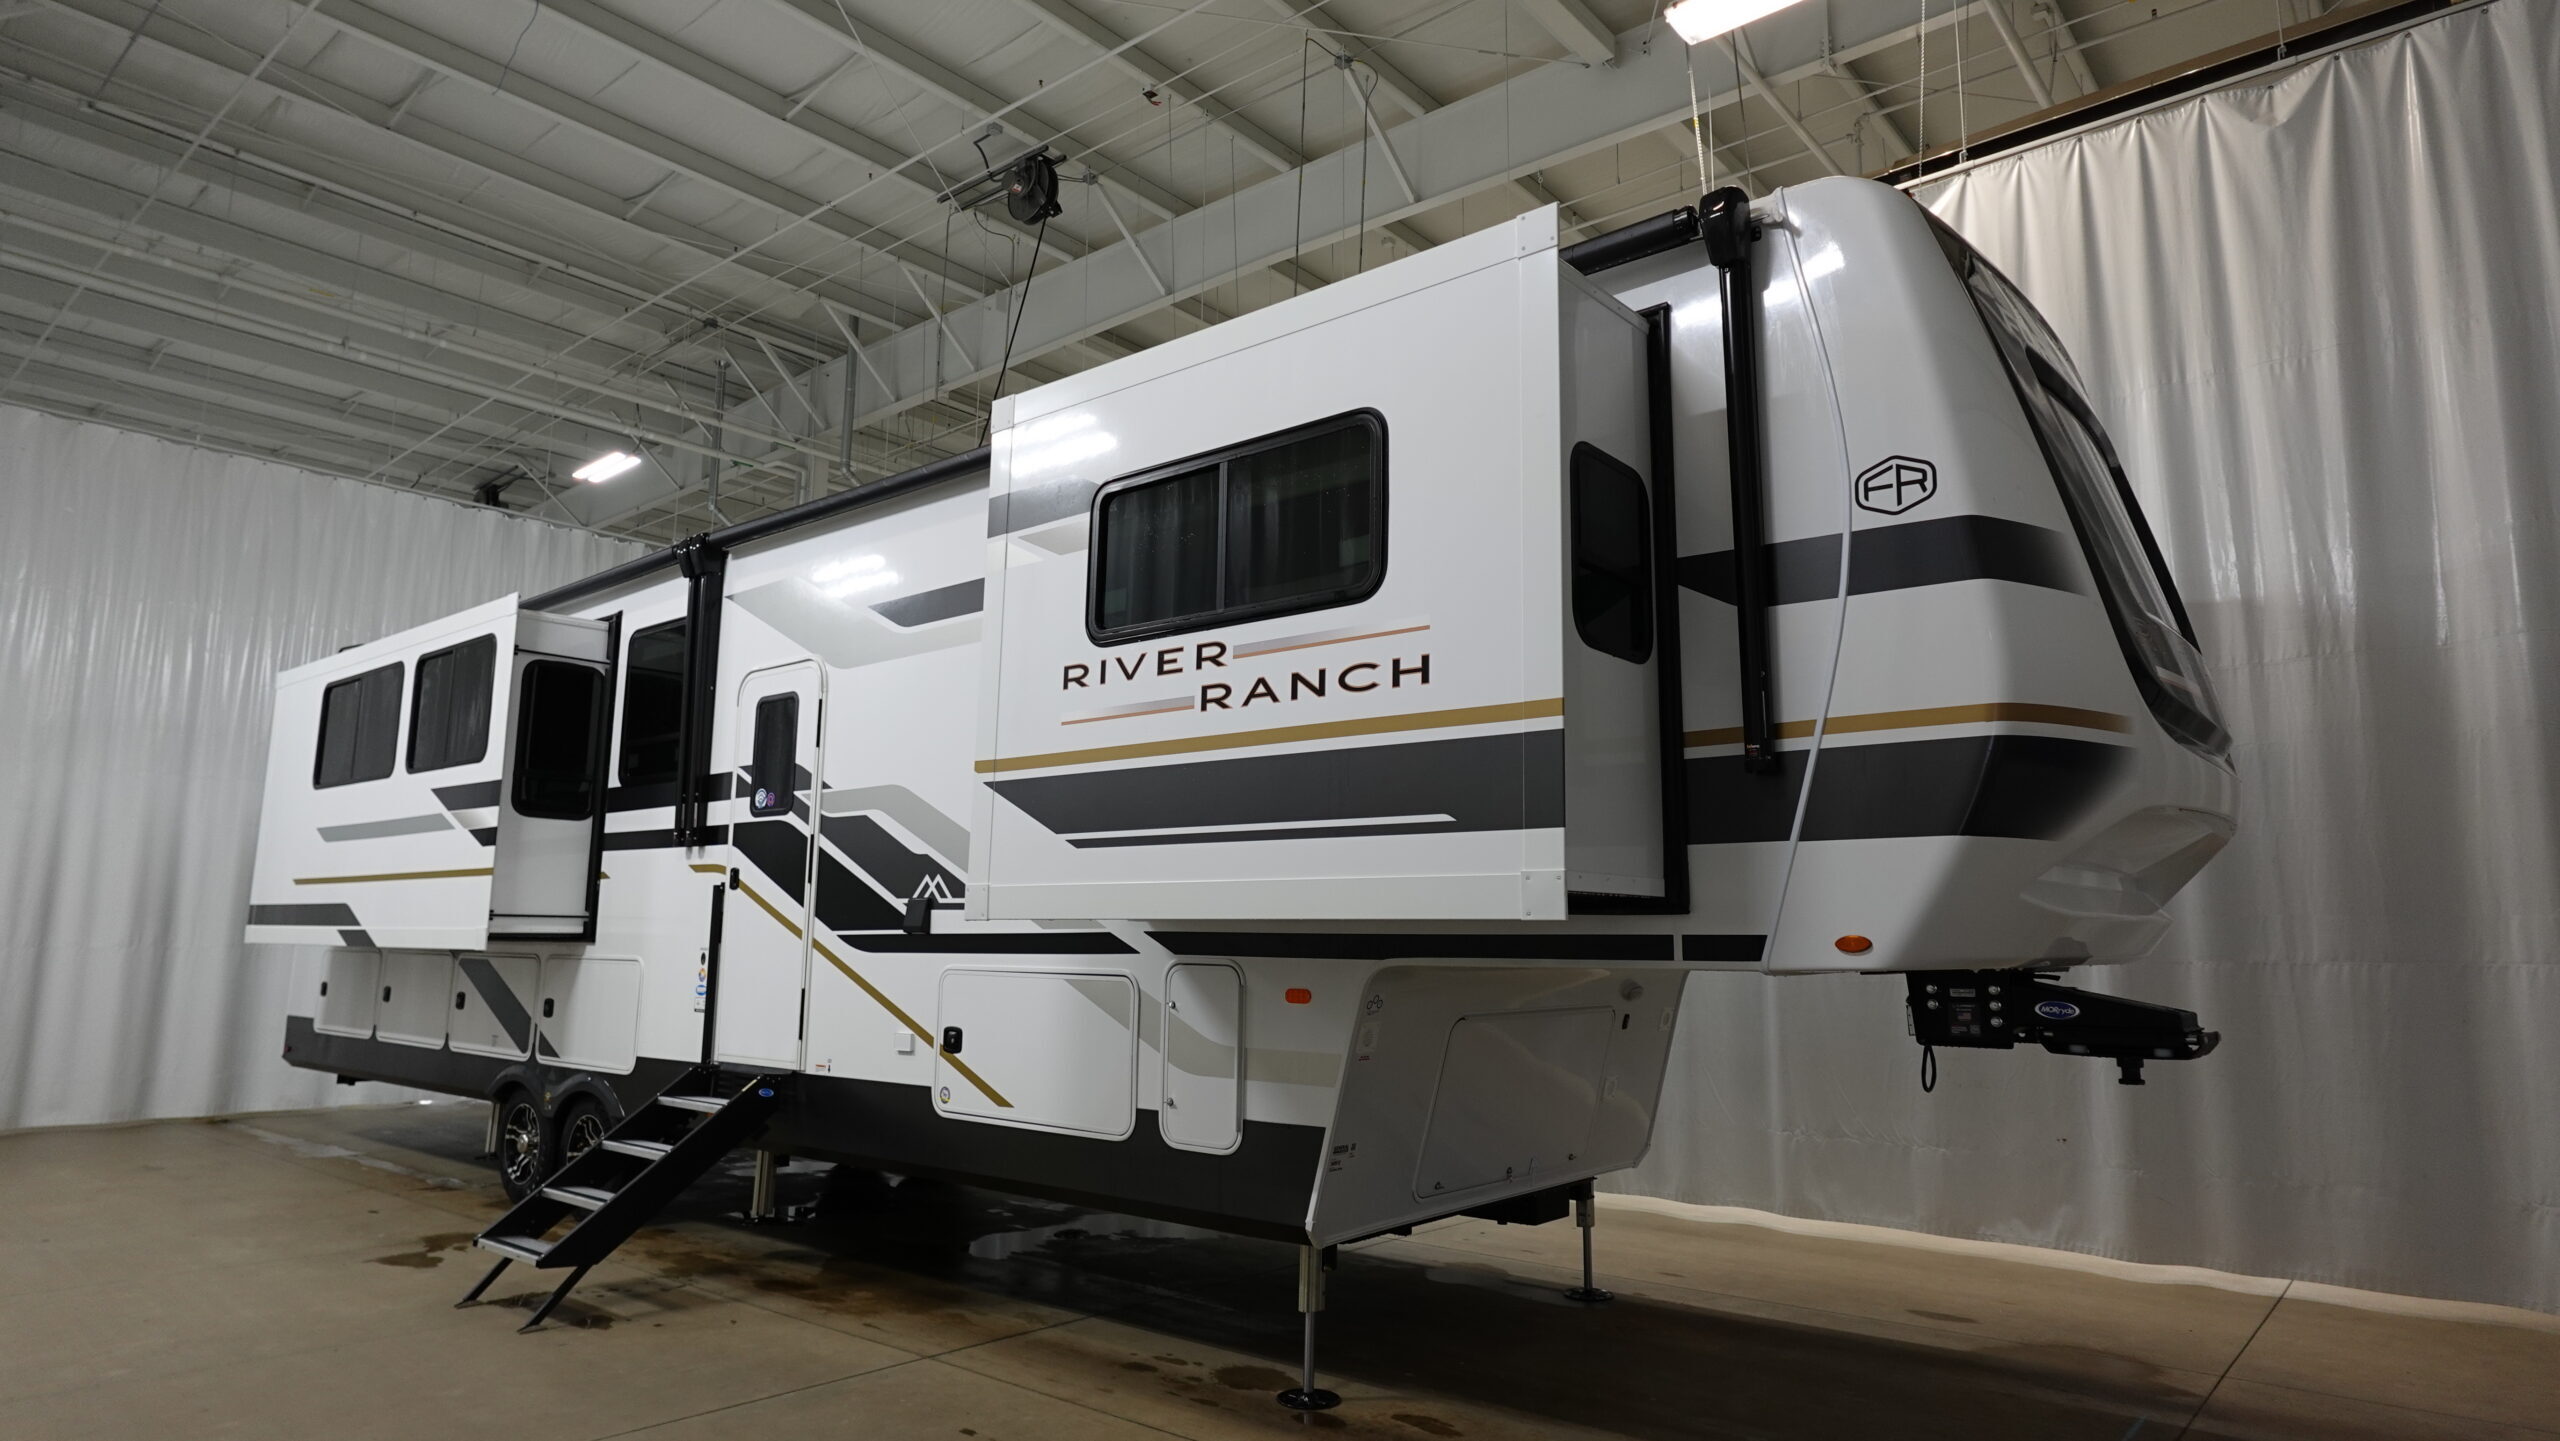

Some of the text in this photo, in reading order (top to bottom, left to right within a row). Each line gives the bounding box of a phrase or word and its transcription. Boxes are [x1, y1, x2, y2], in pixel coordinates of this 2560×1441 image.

[1864, 464, 1927, 506] FR
[1063, 641, 1228, 690] RIVER
[1200, 654, 1430, 712] RANCH
